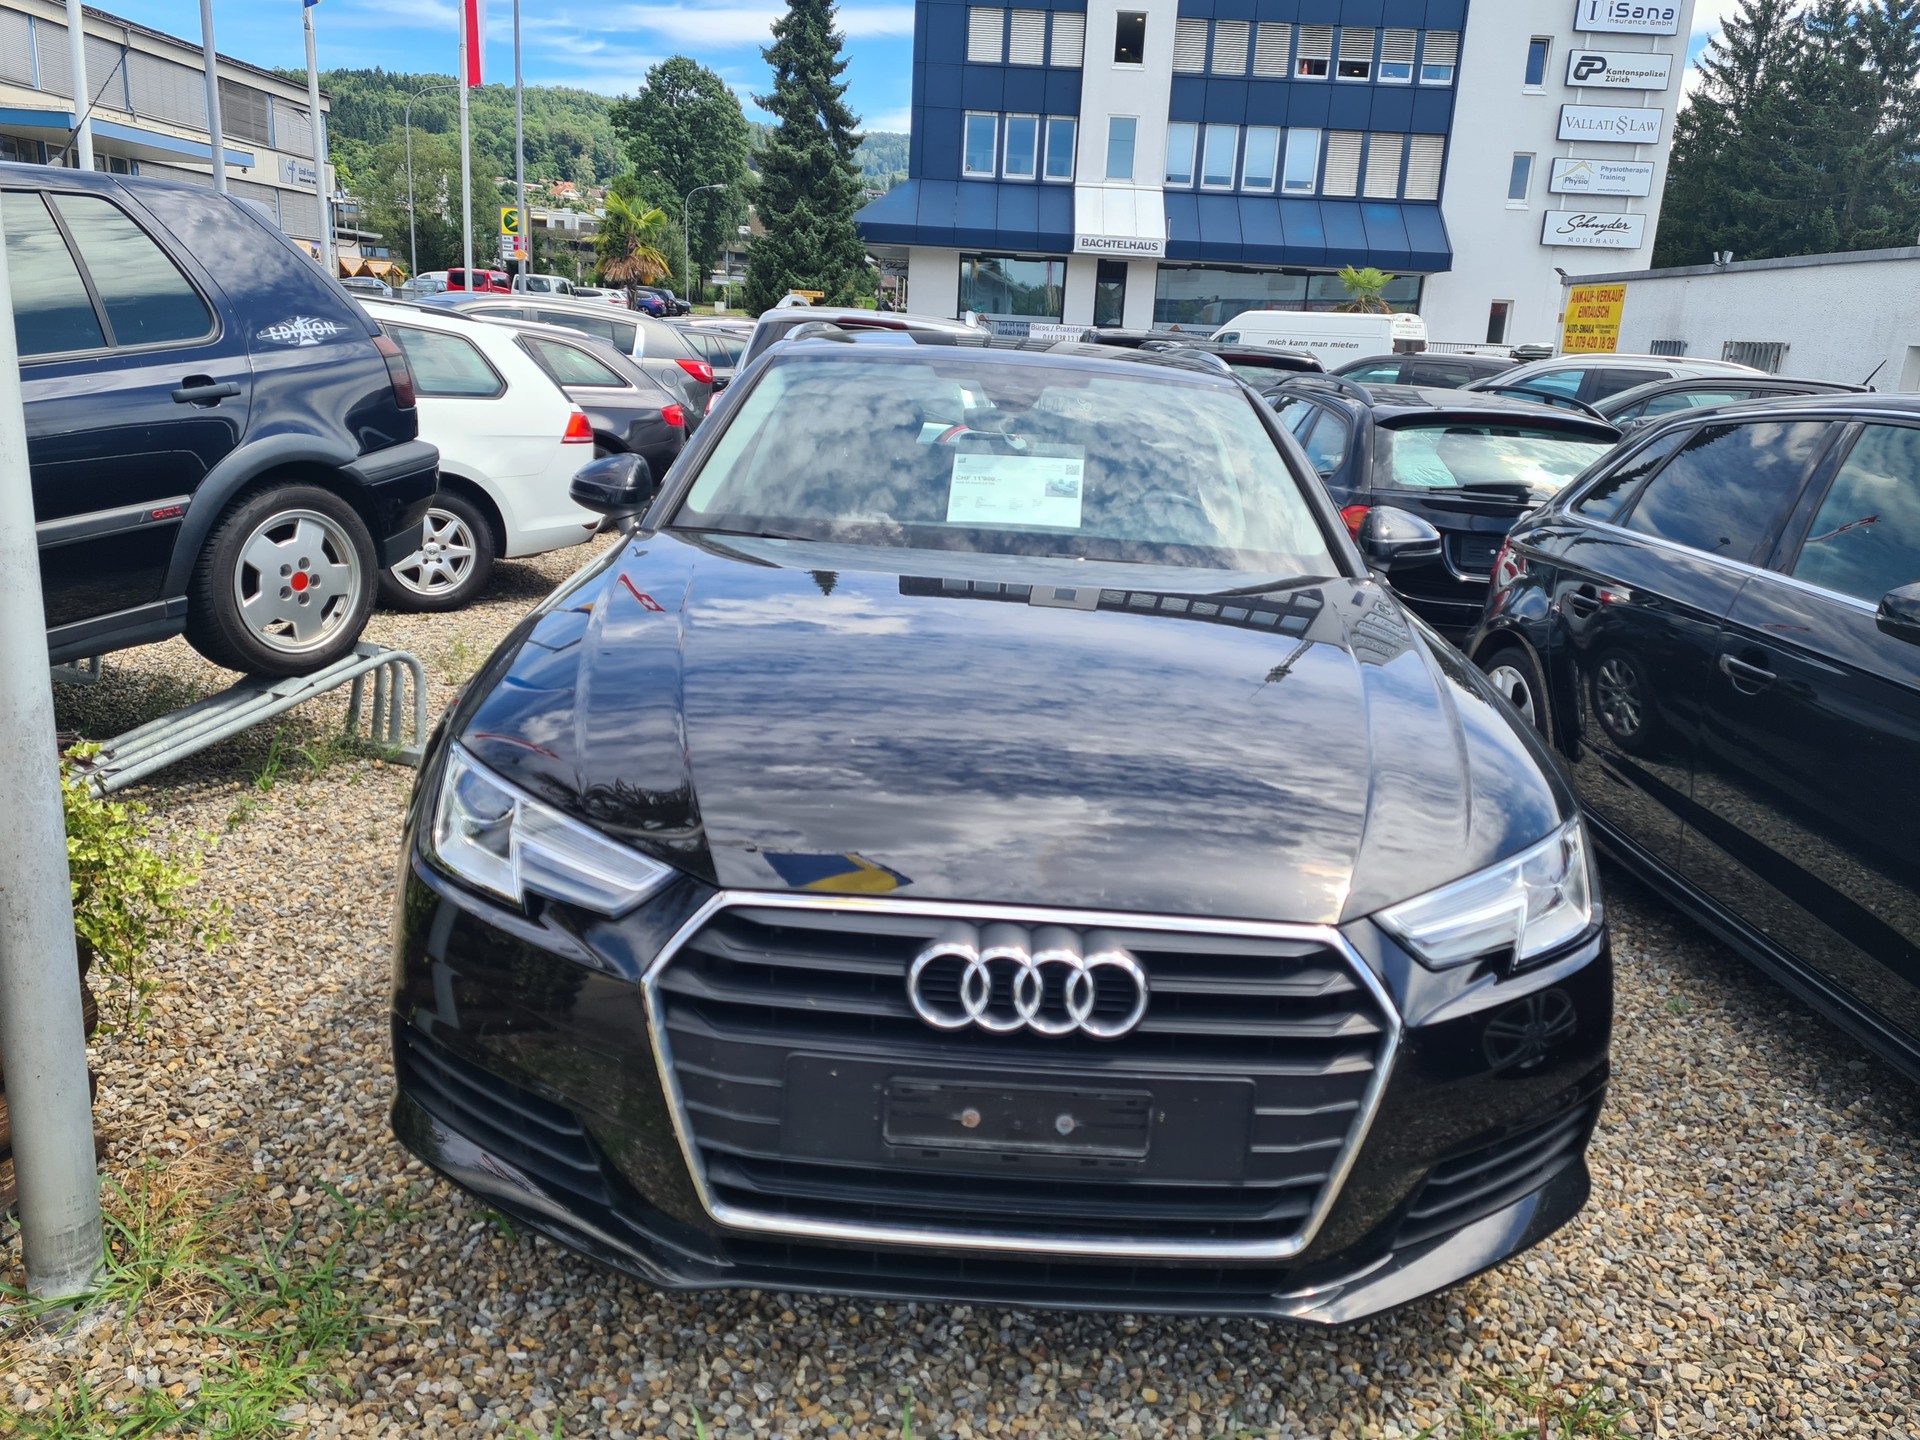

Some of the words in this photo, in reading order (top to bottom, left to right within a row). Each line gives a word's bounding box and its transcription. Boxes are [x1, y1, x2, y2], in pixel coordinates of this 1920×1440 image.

[1608, 1, 1675, 20] iSana
[1606, 68, 1666, 78] Kantonspolizei
[1605, 75, 1630, 83] Zürich
[1600, 166, 1650, 174] Physiotherapie
[1564, 177, 1589, 186] Physio
[1599, 174, 1626, 182] Training
[1556, 214, 1632, 236] Schnyder
[1081, 238, 1159, 251] BACHTELHAUS
[1567, 236, 1621, 245] MODEHAUS
[1578, 305, 1610, 318] EINTAUSCH
[1031, 323, 1050, 331] Büros
[1267, 338, 1287, 346] mich
[1288, 338, 1309, 347] kann
[1330, 341, 1360, 349] mieten
[1575, 335, 1587, 348] 079
[1587, 336, 1598, 349] 420
[1606, 336, 1616, 350] 29
[152, 505, 182, 519] GTI
